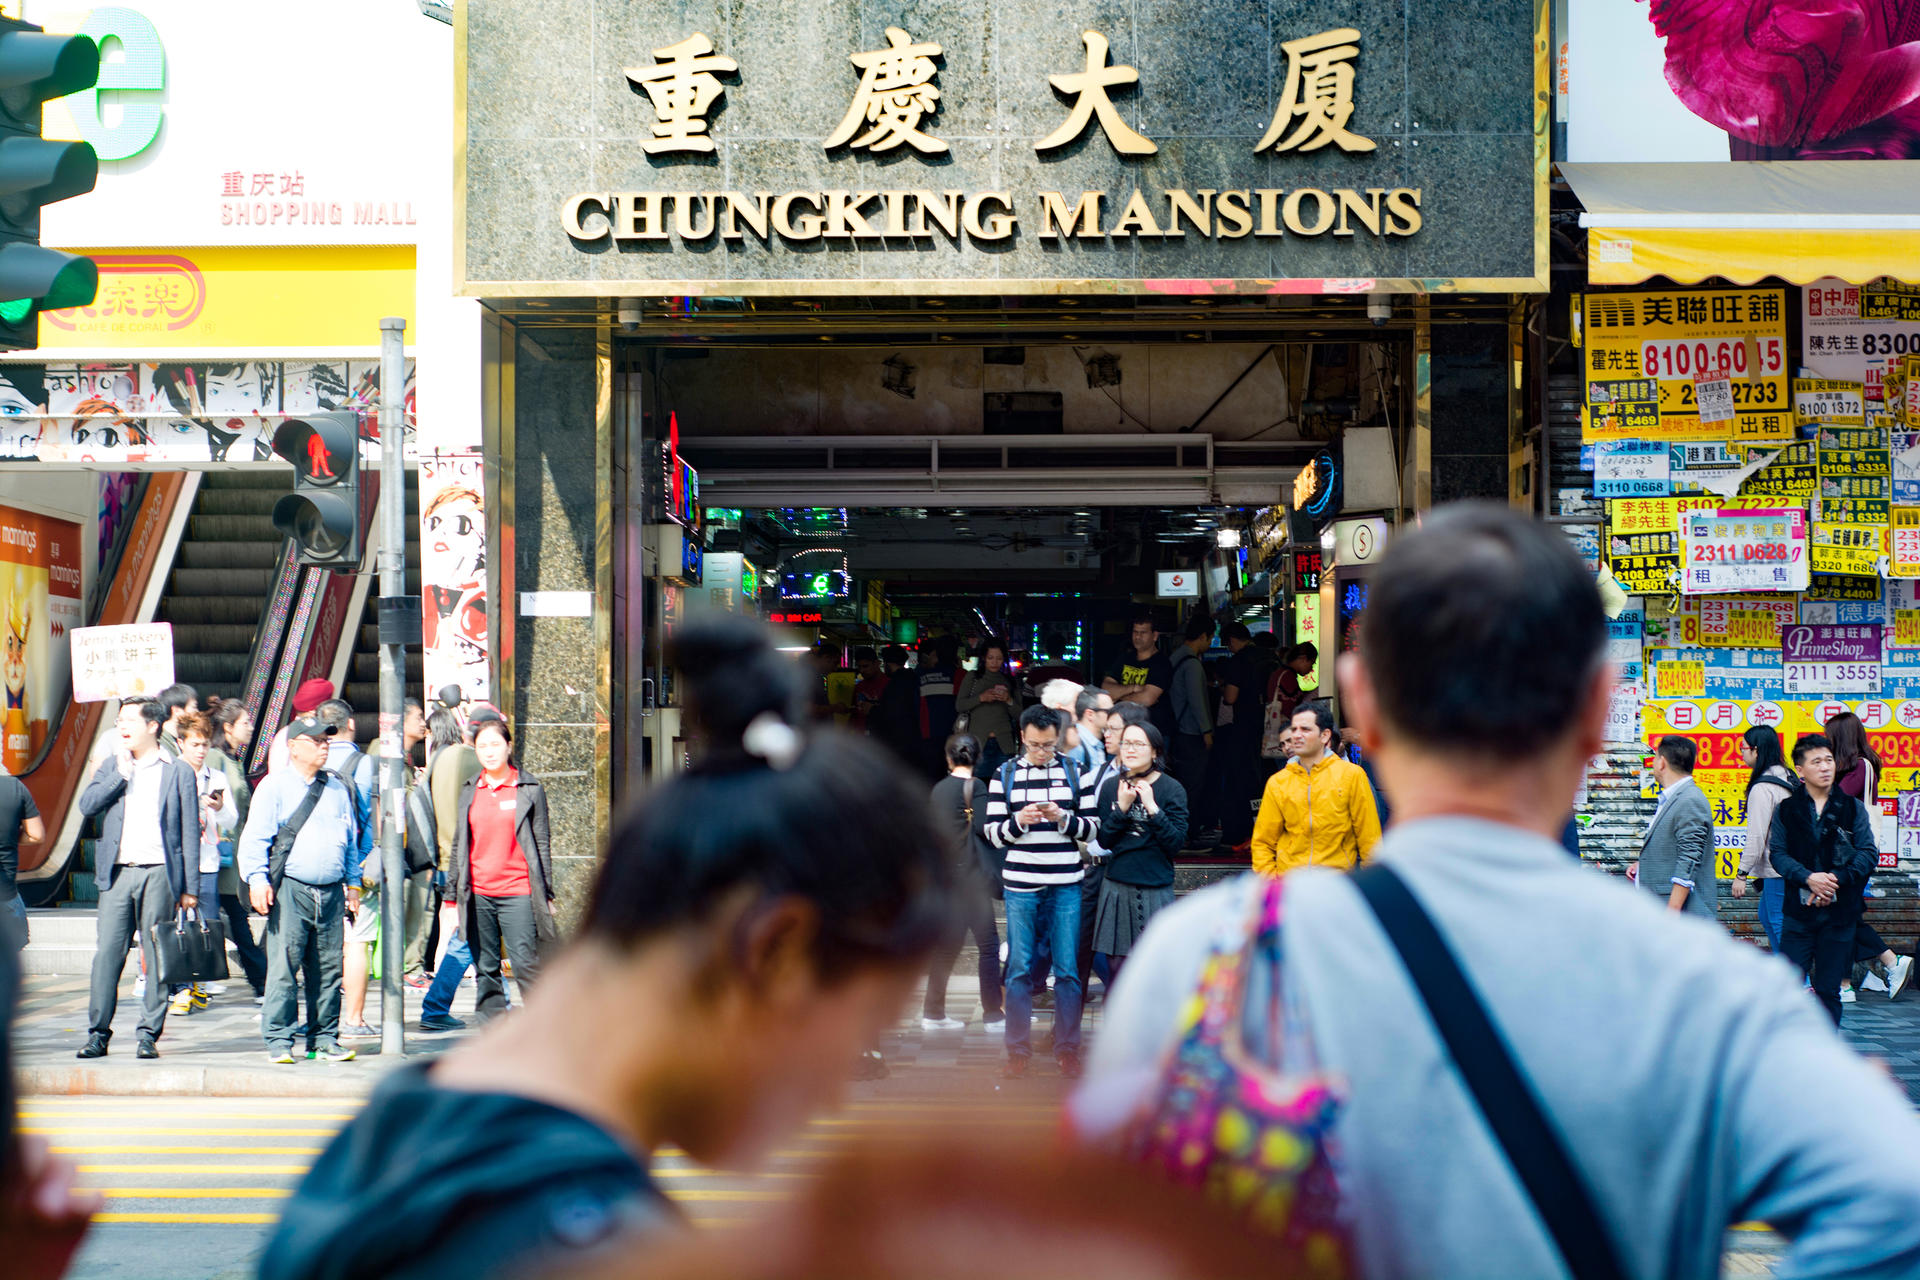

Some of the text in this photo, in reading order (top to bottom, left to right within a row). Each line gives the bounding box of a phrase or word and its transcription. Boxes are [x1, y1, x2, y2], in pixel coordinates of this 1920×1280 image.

[220, 170, 304, 197] 重庆站
[220, 201, 417, 226] SHOPPING MALL
[561, 188, 1423, 240] CHUNGKING MANSIONS
[1642, 293, 1779, 326] 美聯旺舖
[1809, 335, 1859, 351] 陳先生
[1799, 401, 1859, 415] 8100 1372
[1626, 415, 1657, 426] 6469
[1741, 416, 1781, 434] 出租
[1822, 463, 1887, 474] 9106 6332
[1600, 482, 1630, 493] 3110
[1633, 482, 1664, 493] 0668
[1786, 478, 1815, 490] 6469
[1620, 500, 1670, 514] 李先生
[1857, 512, 1887, 521] 6332
[1694, 543, 1787, 562] 2311 0628
[1813, 560, 1842, 571] 9320
[50, 563, 80, 589] mannings
[1614, 570, 1645, 580] 6108
[1695, 569, 1711, 583] 租
[1773, 567, 1787, 582] 售
[1844, 588, 1873, 599] 4400
[1703, 601, 1794, 612] 2311-7368
[1728, 619, 1774, 640] 93419313
[1787, 626, 1865, 660] PrimeShop
[1788, 665, 1877, 680] 2111 3555
[1658, 671, 1704, 690] 93419313
[1788, 682, 1798, 692] 租
